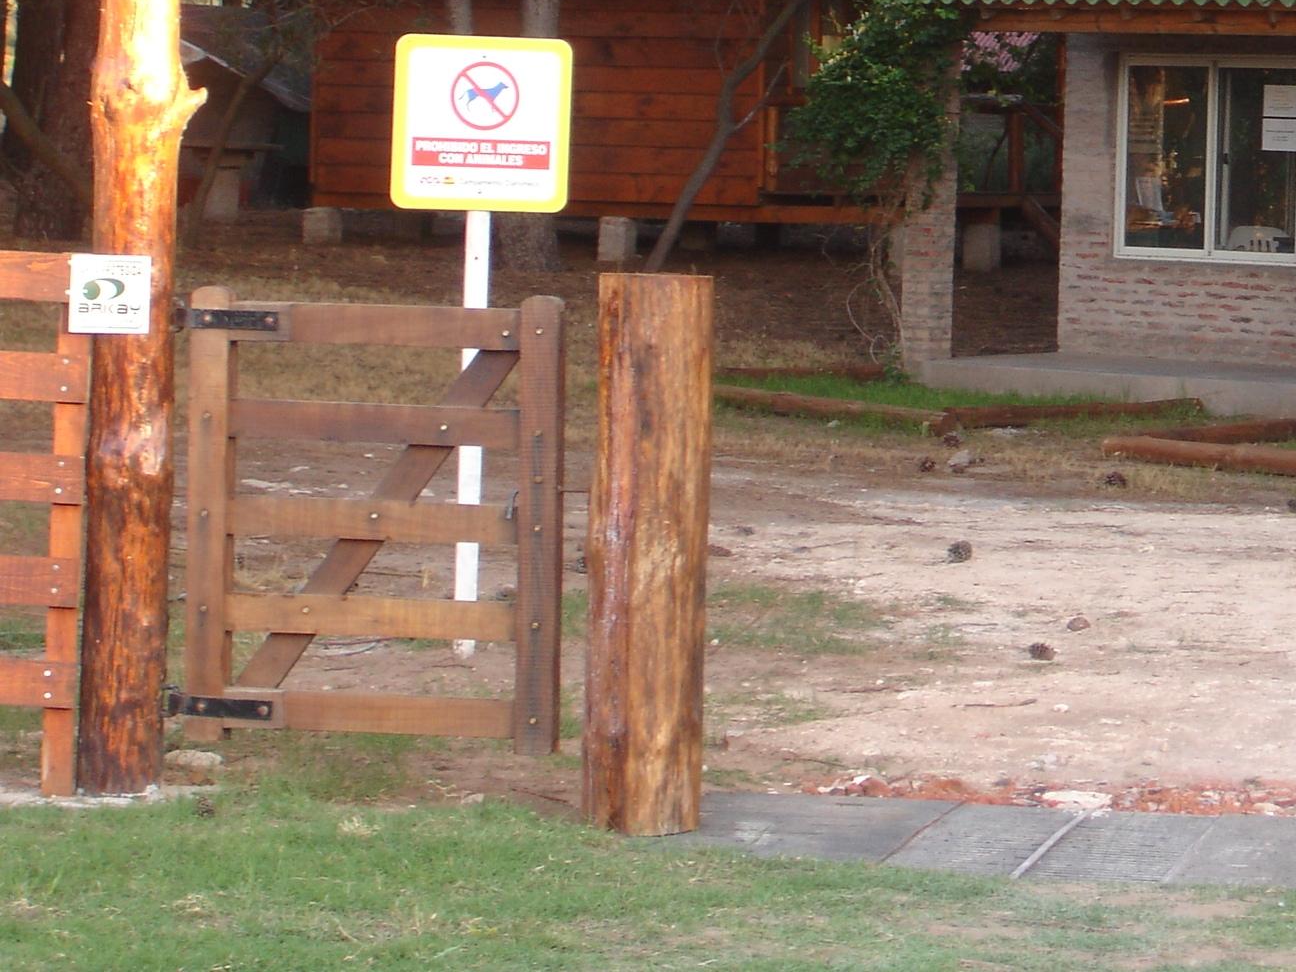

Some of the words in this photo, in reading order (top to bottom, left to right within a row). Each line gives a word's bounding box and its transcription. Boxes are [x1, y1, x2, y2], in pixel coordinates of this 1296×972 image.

[415, 139, 479, 154] PROHIBIDO
[480, 142, 494, 154] EL
[496, 143, 548, 156] INGRESO
[438, 152, 464, 165] CON
[465, 153, 524, 166] ANIMALES
